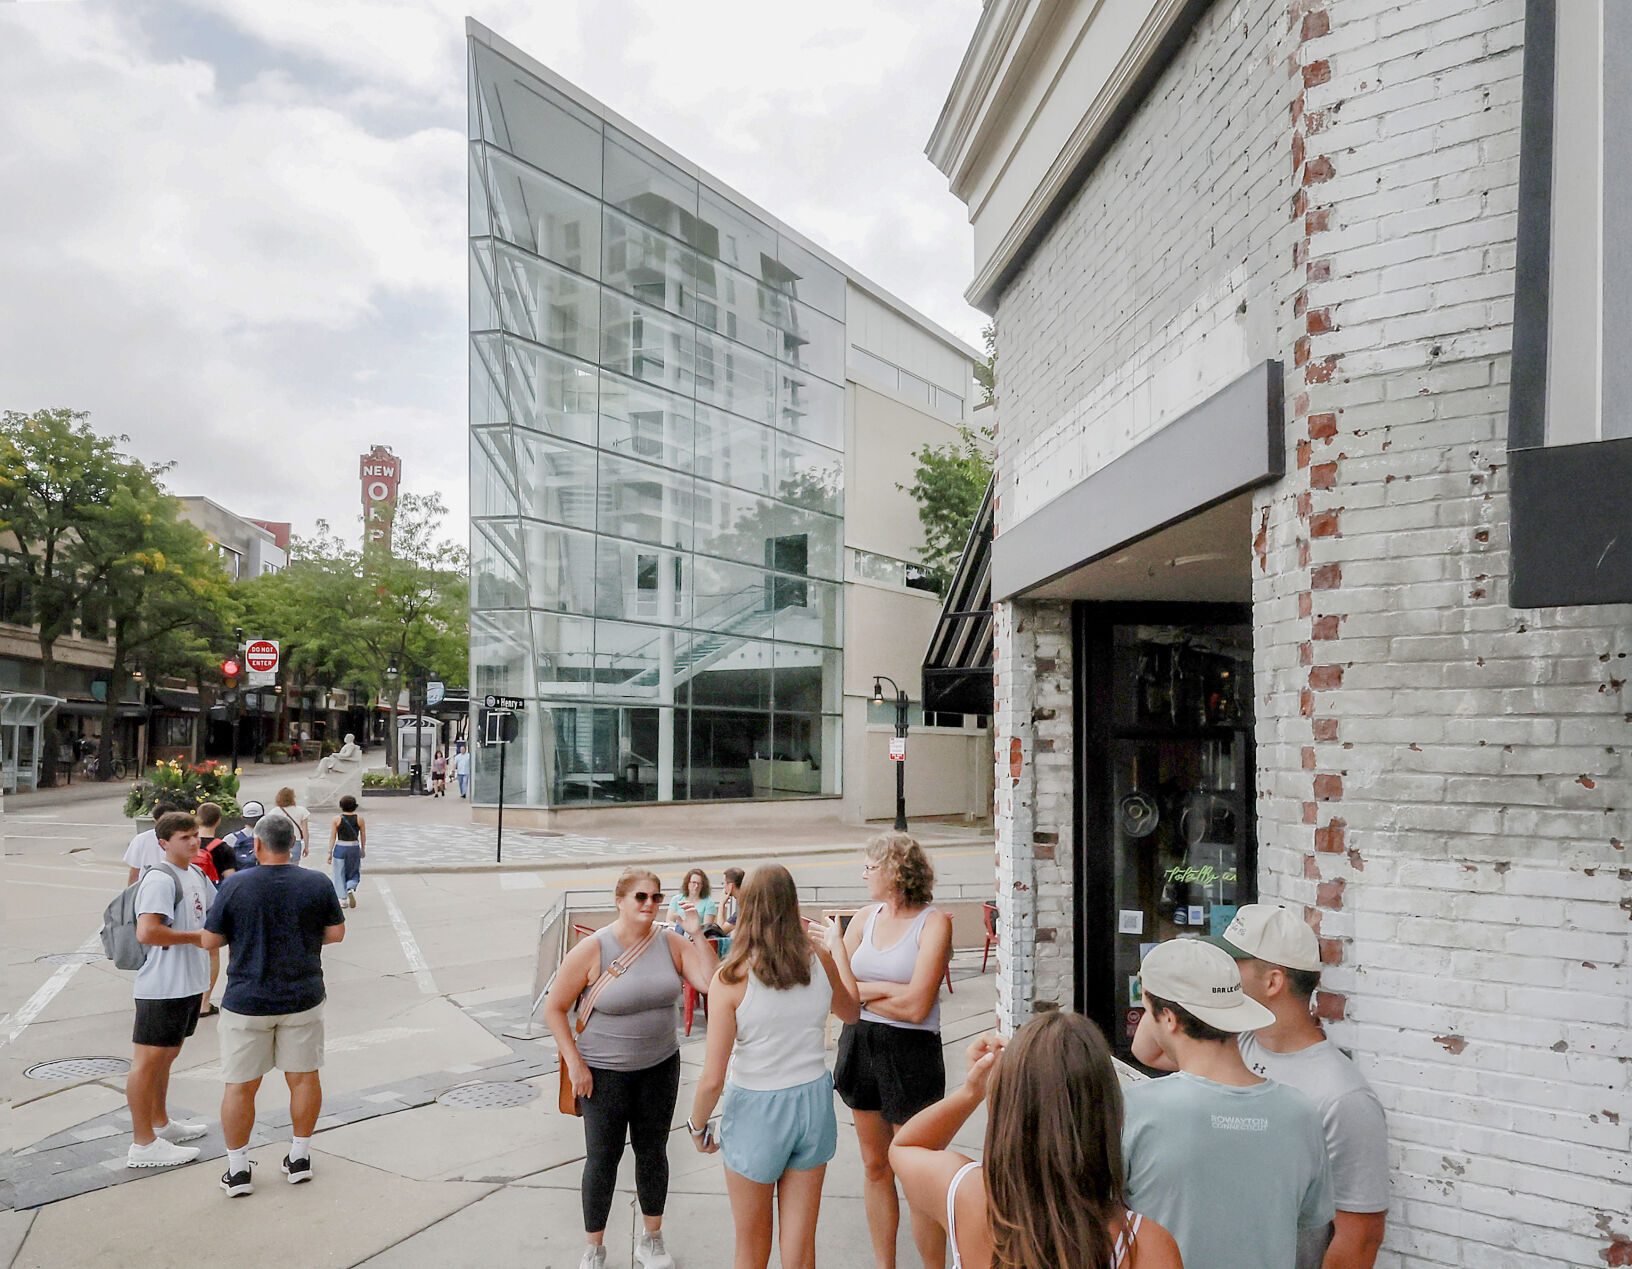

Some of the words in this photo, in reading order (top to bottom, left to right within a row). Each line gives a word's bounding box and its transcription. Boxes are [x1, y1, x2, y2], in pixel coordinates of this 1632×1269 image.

[363, 466, 394, 477] NEW
[500, 697, 518, 710] Henry
[1164, 865, 1219, 884] Totally
[1211, 1115, 1268, 1126] ROWAYTON
